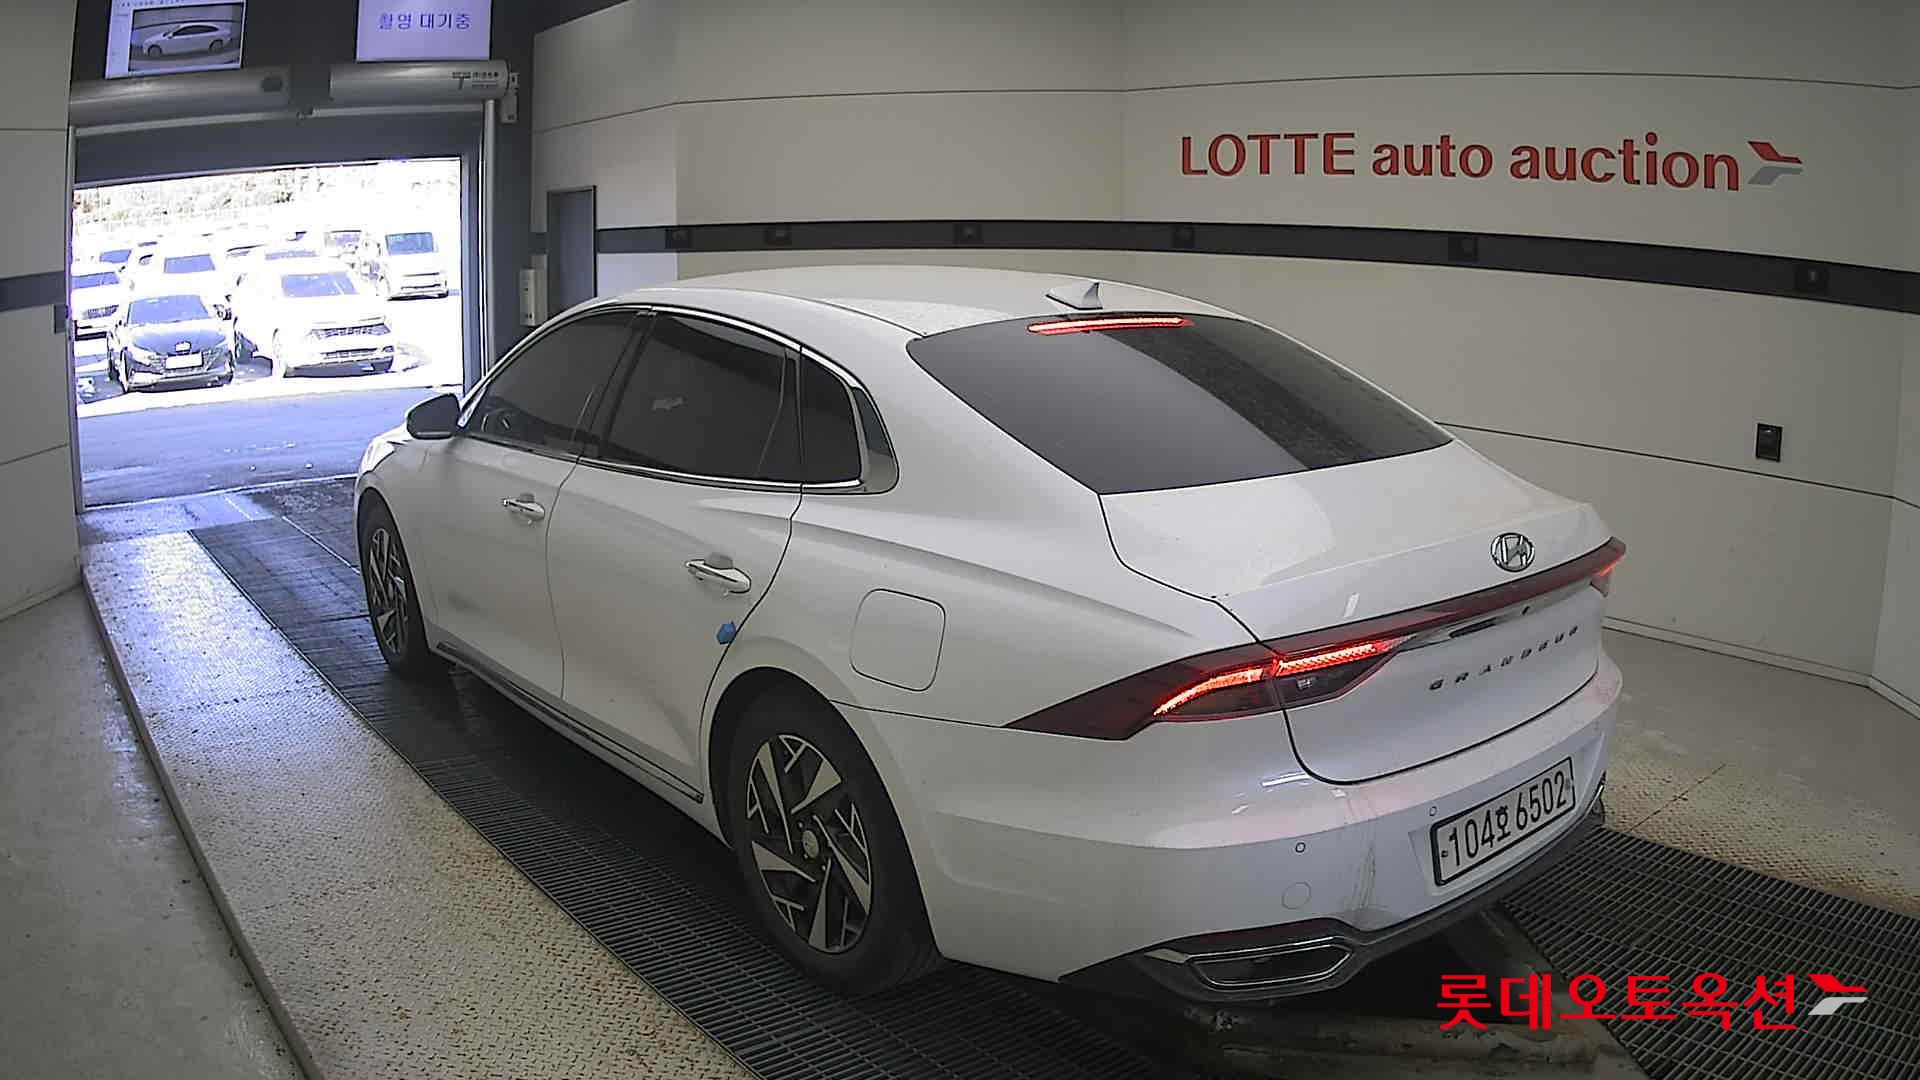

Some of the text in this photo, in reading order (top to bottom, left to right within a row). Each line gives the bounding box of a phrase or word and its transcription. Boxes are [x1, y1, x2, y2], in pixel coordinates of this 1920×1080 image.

[420, 13, 471, 30] 대기중
[1181, 131, 1740, 192] LOTTE auto auction
[1516, 770, 1567, 831] 6502
